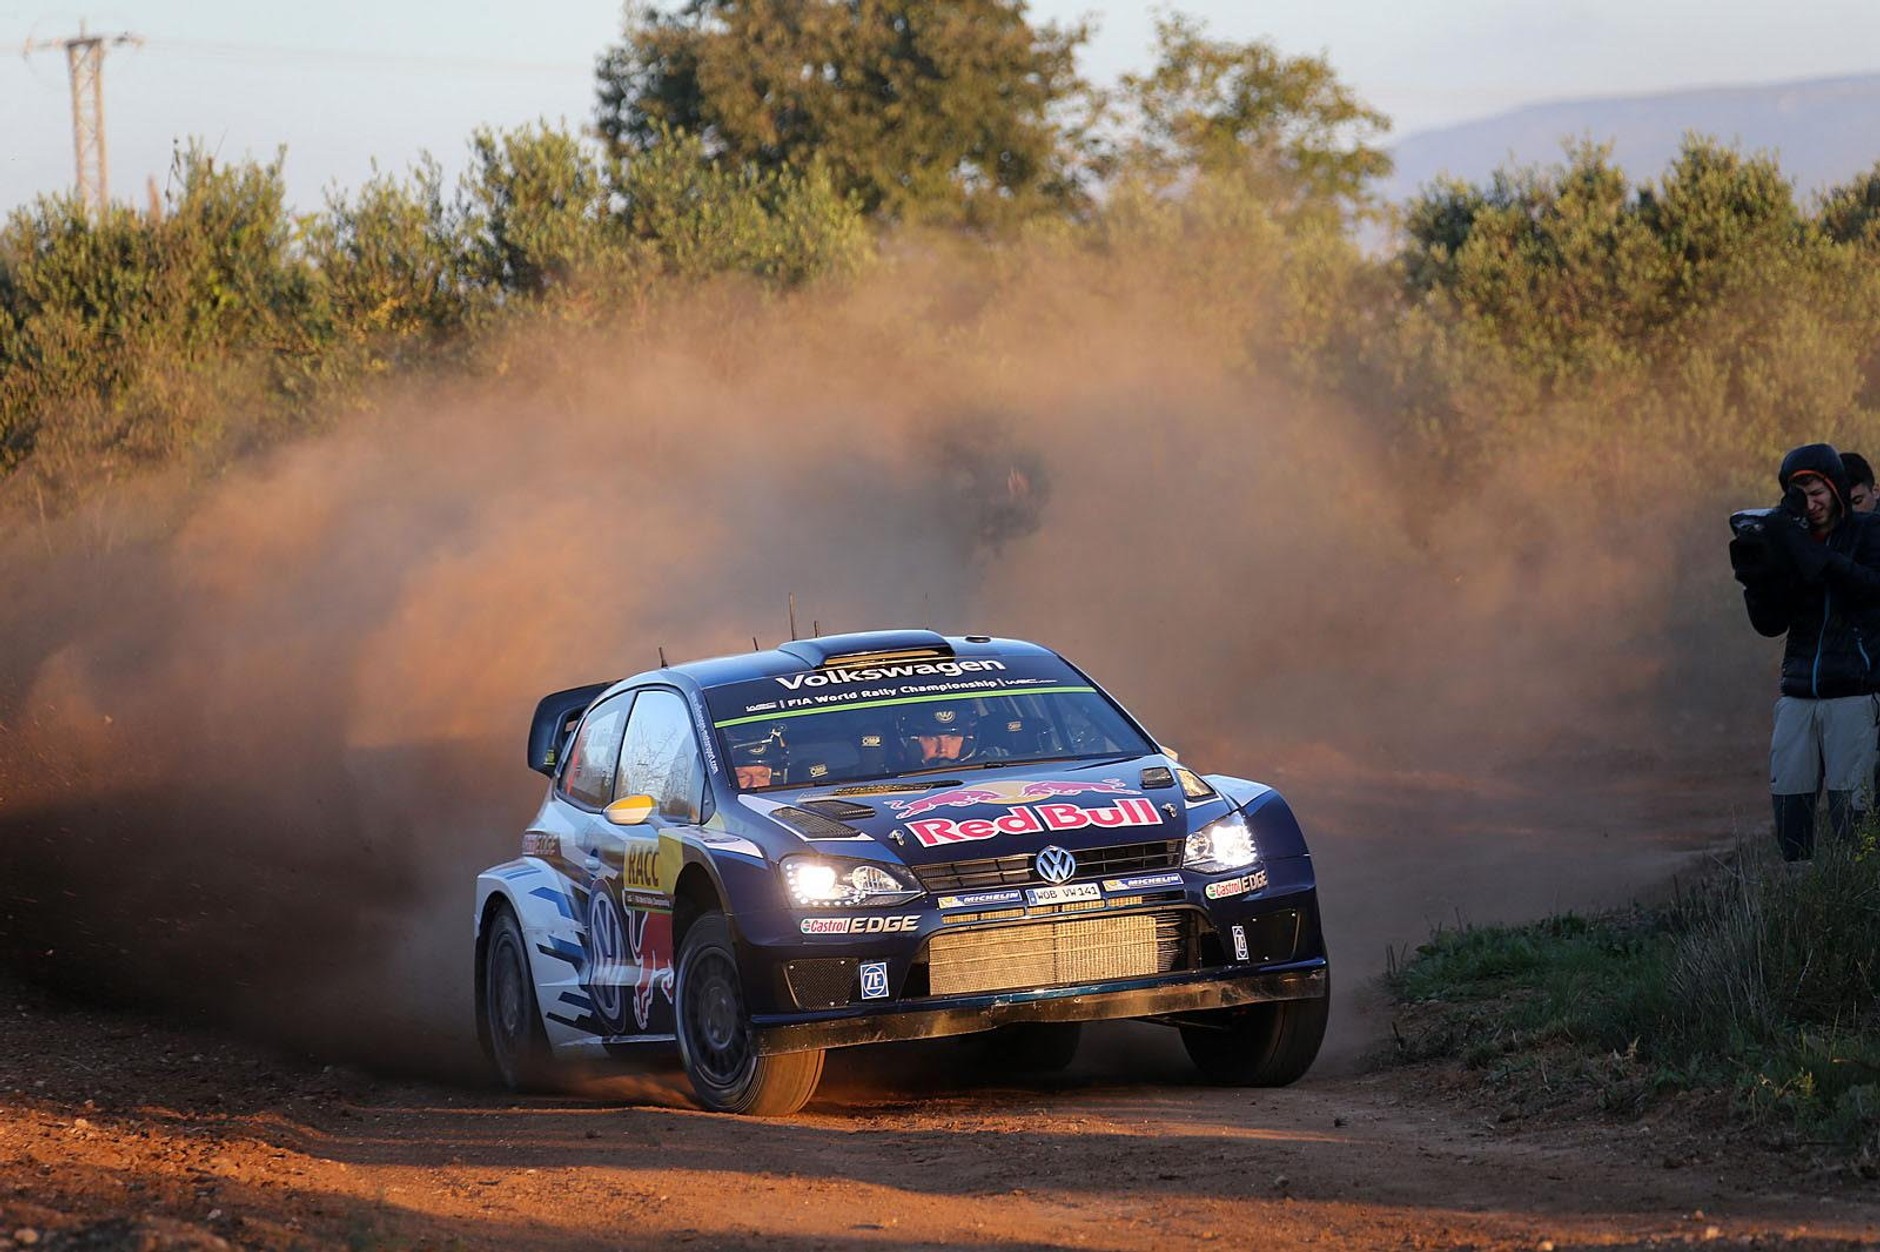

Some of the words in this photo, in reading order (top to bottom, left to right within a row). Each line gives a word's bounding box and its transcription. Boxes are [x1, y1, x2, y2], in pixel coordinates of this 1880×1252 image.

[776, 658, 1006, 690] Volkswagen
[787, 696, 812, 708] FIA
[814, 691, 858, 704] World
[861, 687, 897, 701] Rally
[900, 679, 996, 694] Championship
[908, 807, 1042, 846] Red
[1039, 798, 1163, 829] Bull
[628, 845, 660, 887] RACC
[1127, 874, 1180, 886] MICHELIN
[1216, 881, 1241, 897] Castrol
[1242, 871, 1268, 891] EDGE
[964, 890, 1019, 903] MICHELIN
[1036, 890, 1058, 900] WOB
[810, 919, 847, 933] Castrol
[848, 914, 921, 933] EDGE
[864, 971, 885, 990] ZF
